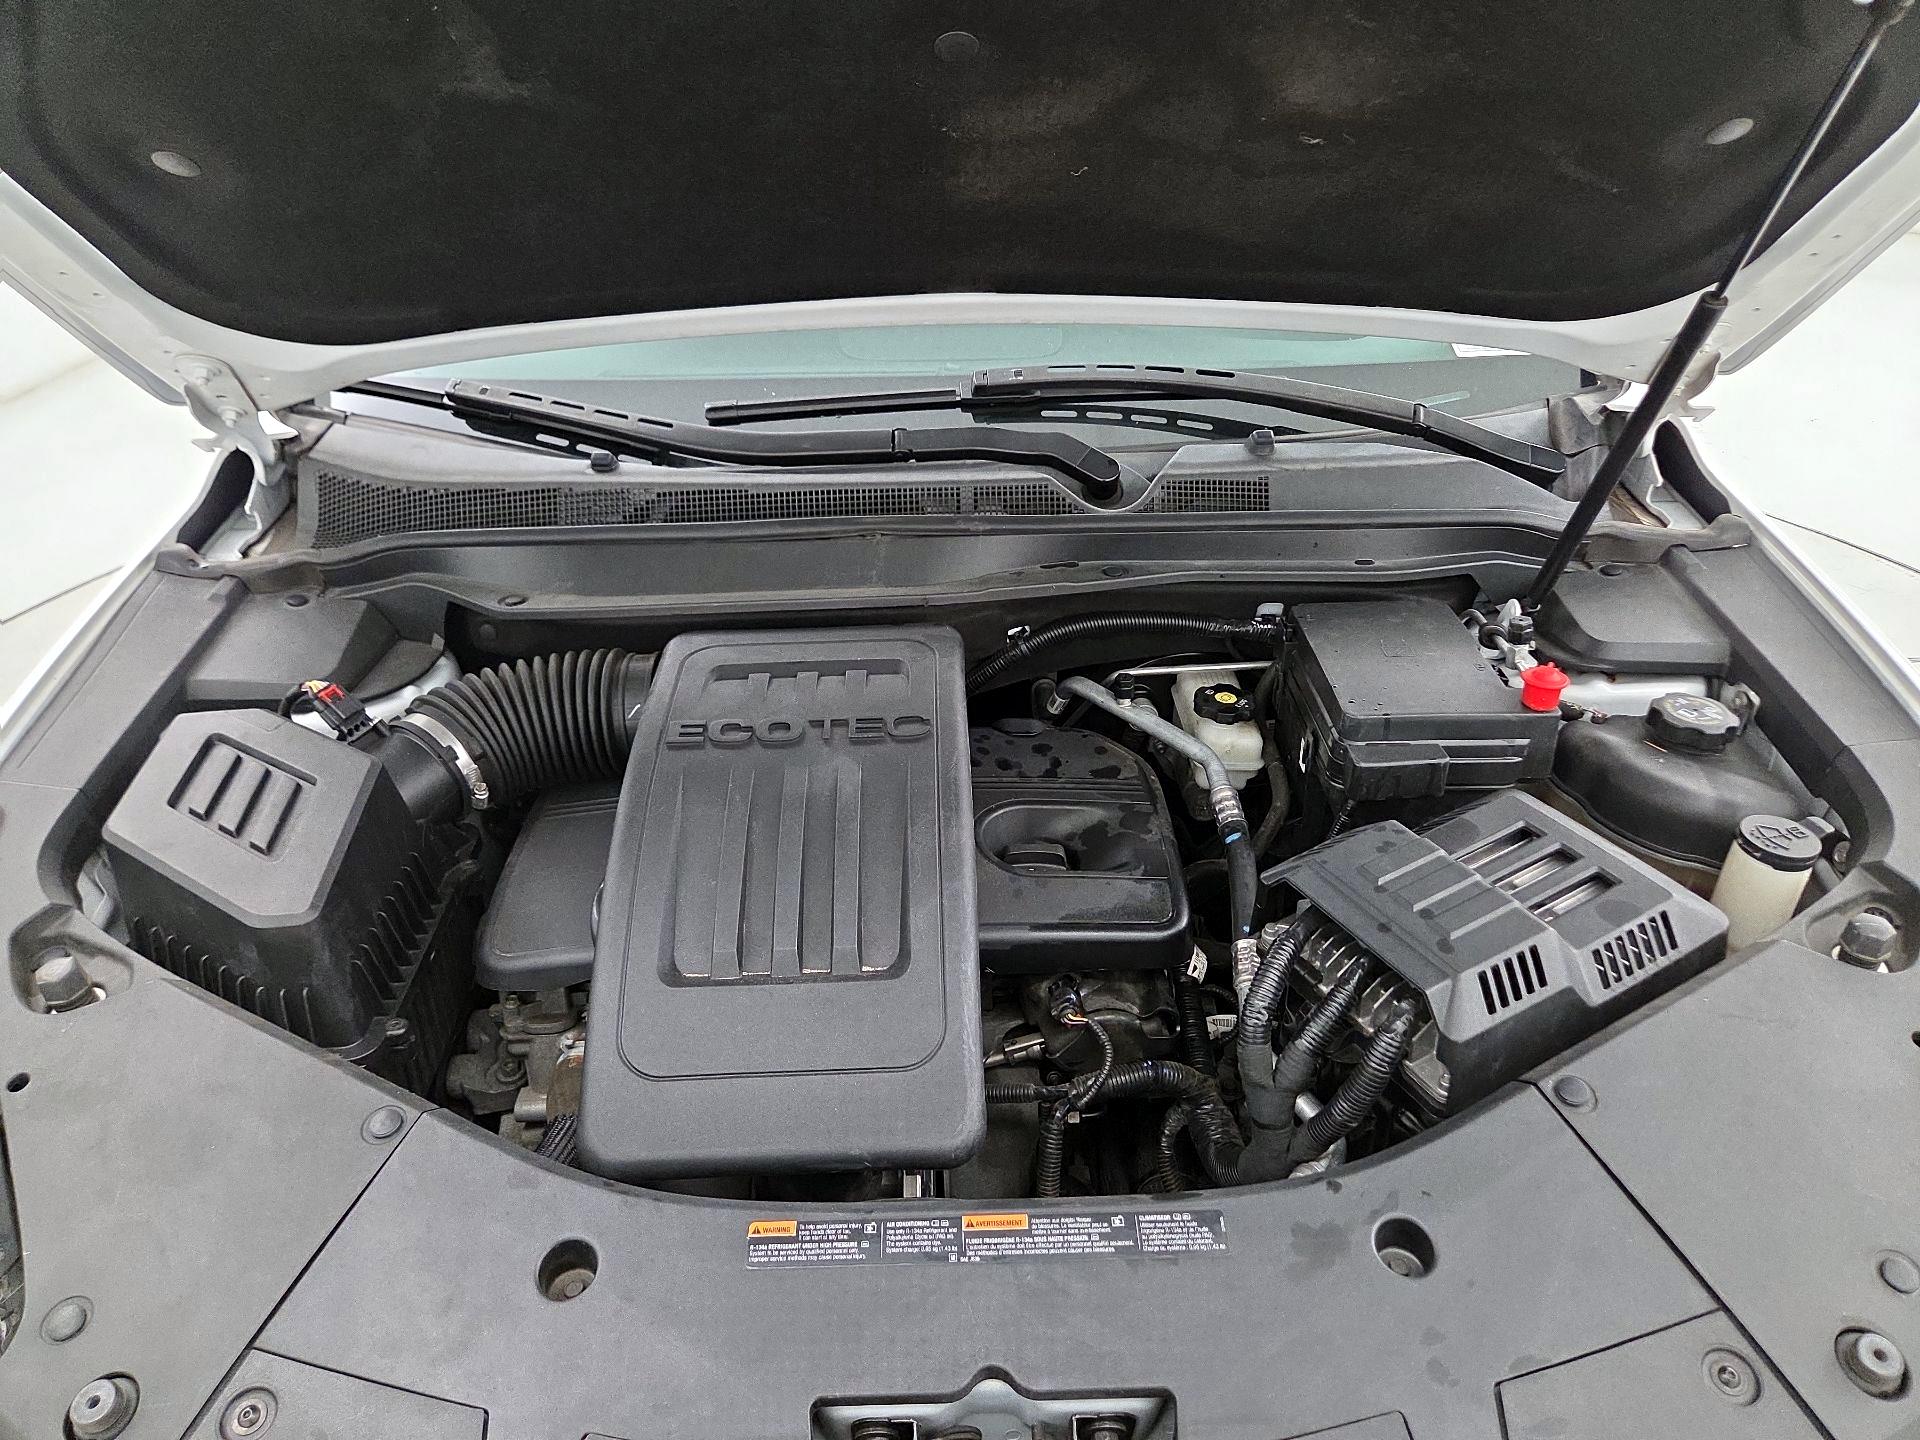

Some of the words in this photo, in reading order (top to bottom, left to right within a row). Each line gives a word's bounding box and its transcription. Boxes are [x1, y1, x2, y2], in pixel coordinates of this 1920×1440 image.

[666, 715, 931, 749] ECOTEC
[975, 1219, 1023, 1228] AVERTISSEMENT
[762, 1227, 791, 1235] WARNING
